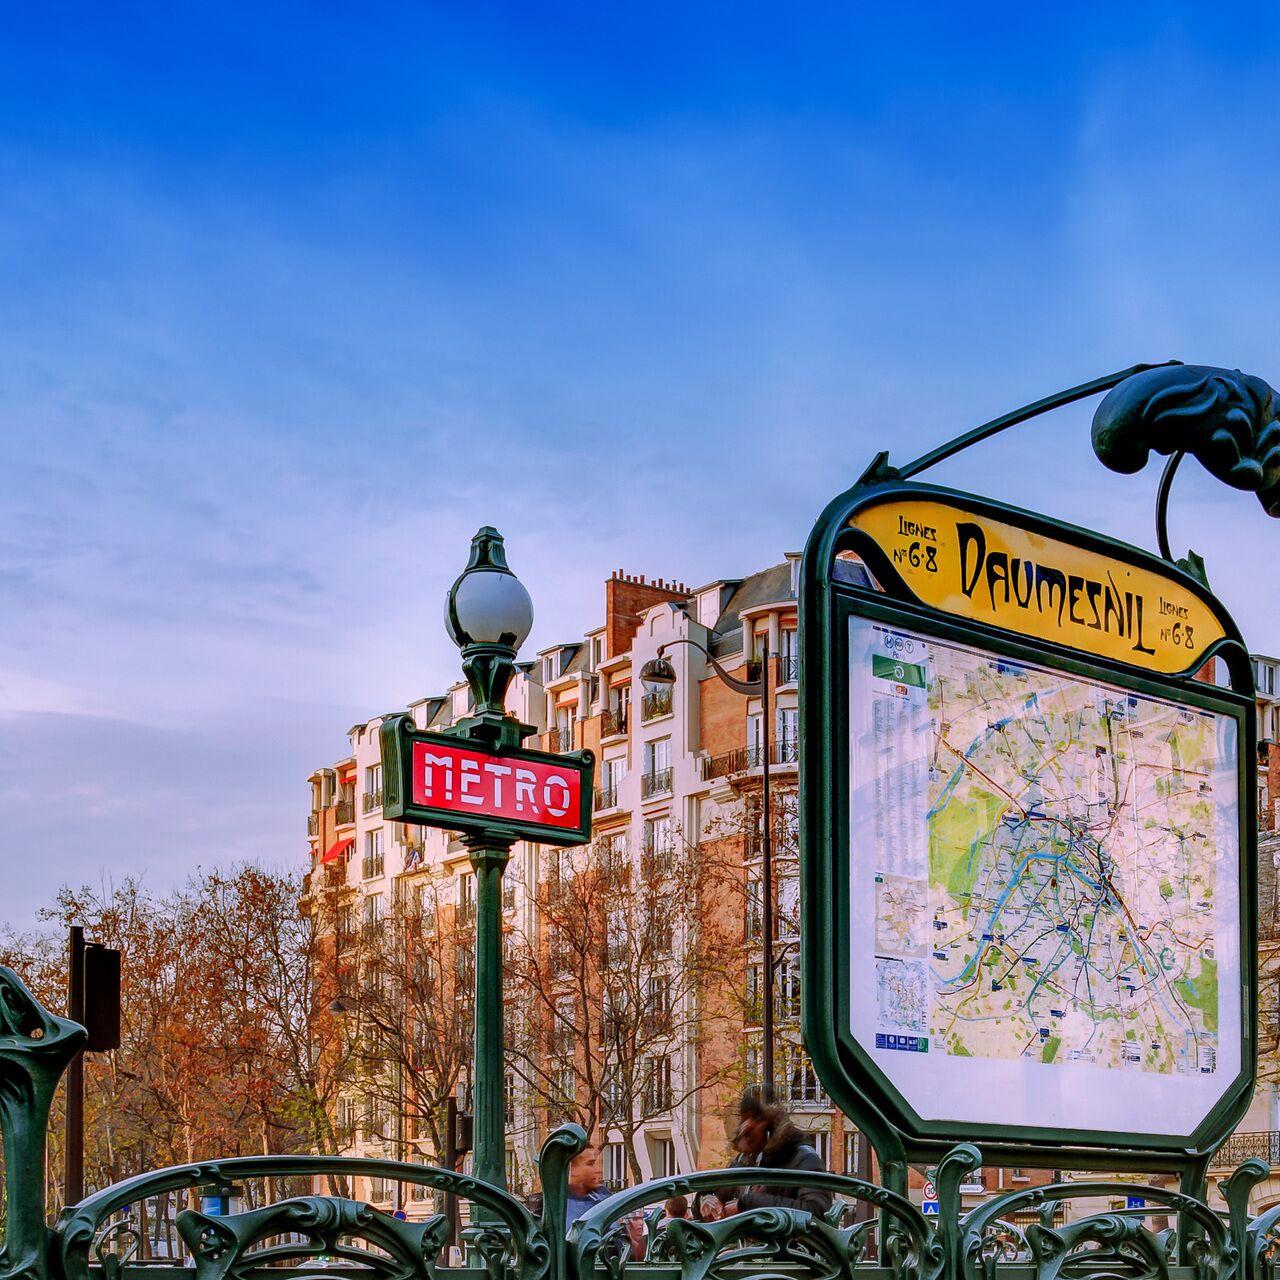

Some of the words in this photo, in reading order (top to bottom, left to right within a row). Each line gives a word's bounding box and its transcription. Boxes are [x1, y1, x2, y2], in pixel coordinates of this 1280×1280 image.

[898, 515, 937, 542] LIGNES
[955, 522, 1156, 656] DAUMESNIL
[1159, 596, 1189, 620] LIGNES
[424, 752, 570, 818] METRO
